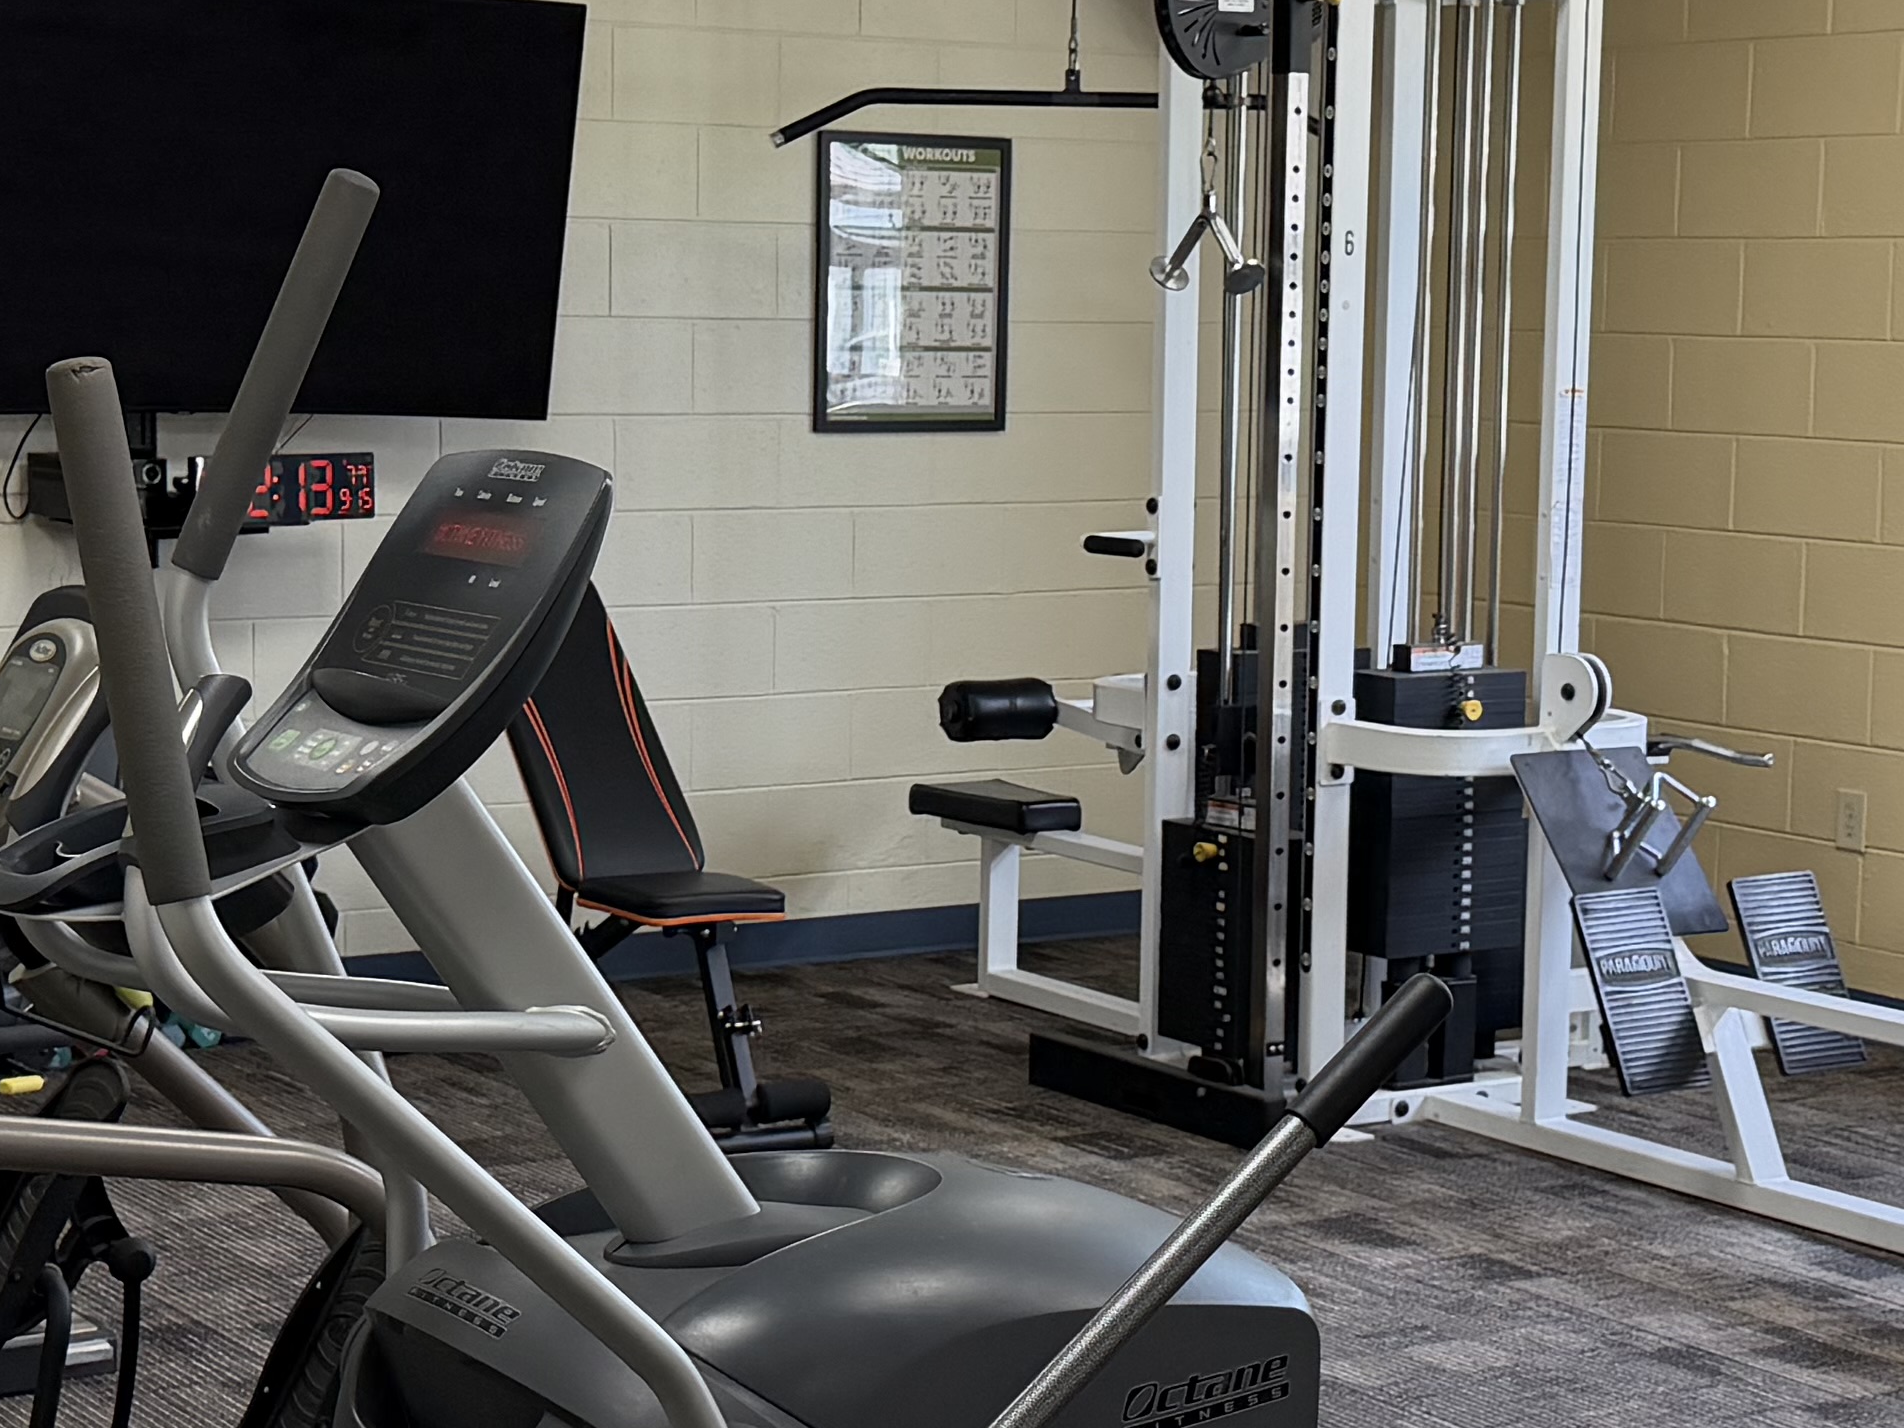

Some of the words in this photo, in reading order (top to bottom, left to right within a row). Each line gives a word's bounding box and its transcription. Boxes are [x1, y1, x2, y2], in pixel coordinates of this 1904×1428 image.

[902, 146, 976, 163] WORKOUTS
[1344, 230, 1355, 256] 6
[410, 1288, 502, 1336] FITNESS
[418, 1268, 522, 1325] Octane
[1123, 1355, 1289, 1422] Octane
